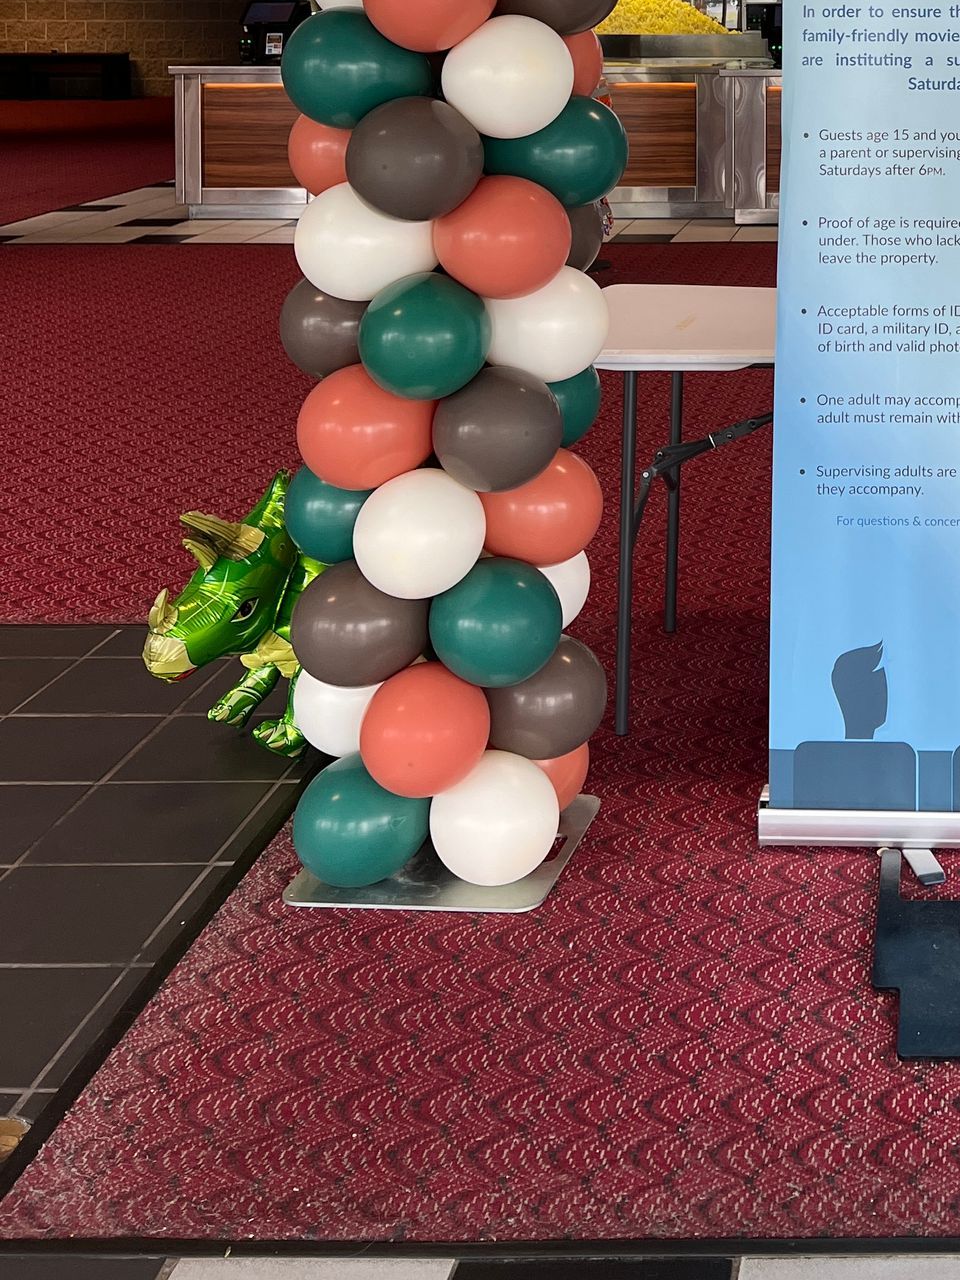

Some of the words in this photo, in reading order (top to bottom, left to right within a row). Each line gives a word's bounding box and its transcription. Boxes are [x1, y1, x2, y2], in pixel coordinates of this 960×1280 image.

[803, 5, 815, 18] In
[822, 4, 862, 18] order
[868, 6, 884, 18] to
[891, 8, 942, 18] ensure
[802, 28, 909, 45] family-friendly
[915, 28, 960, 42] movie
[819, 129, 863, 141] Guests
[866, 132, 889, 143] age
[894, 129, 909, 141] 15
[913, 129, 936, 141] and
[819, 164, 881, 178] Saturdays
[885, 163, 915, 176] after
[819, 252, 852, 264] leave
[856, 252, 877, 264] the
[881, 252, 938, 266] property.
[817, 394, 844, 406] One
[848, 393, 880, 405] adult
[885, 396, 911, 408] may
[837, 515, 854, 526] For
[857, 516, 909, 527] questions
[912, 516, 922, 527] &
